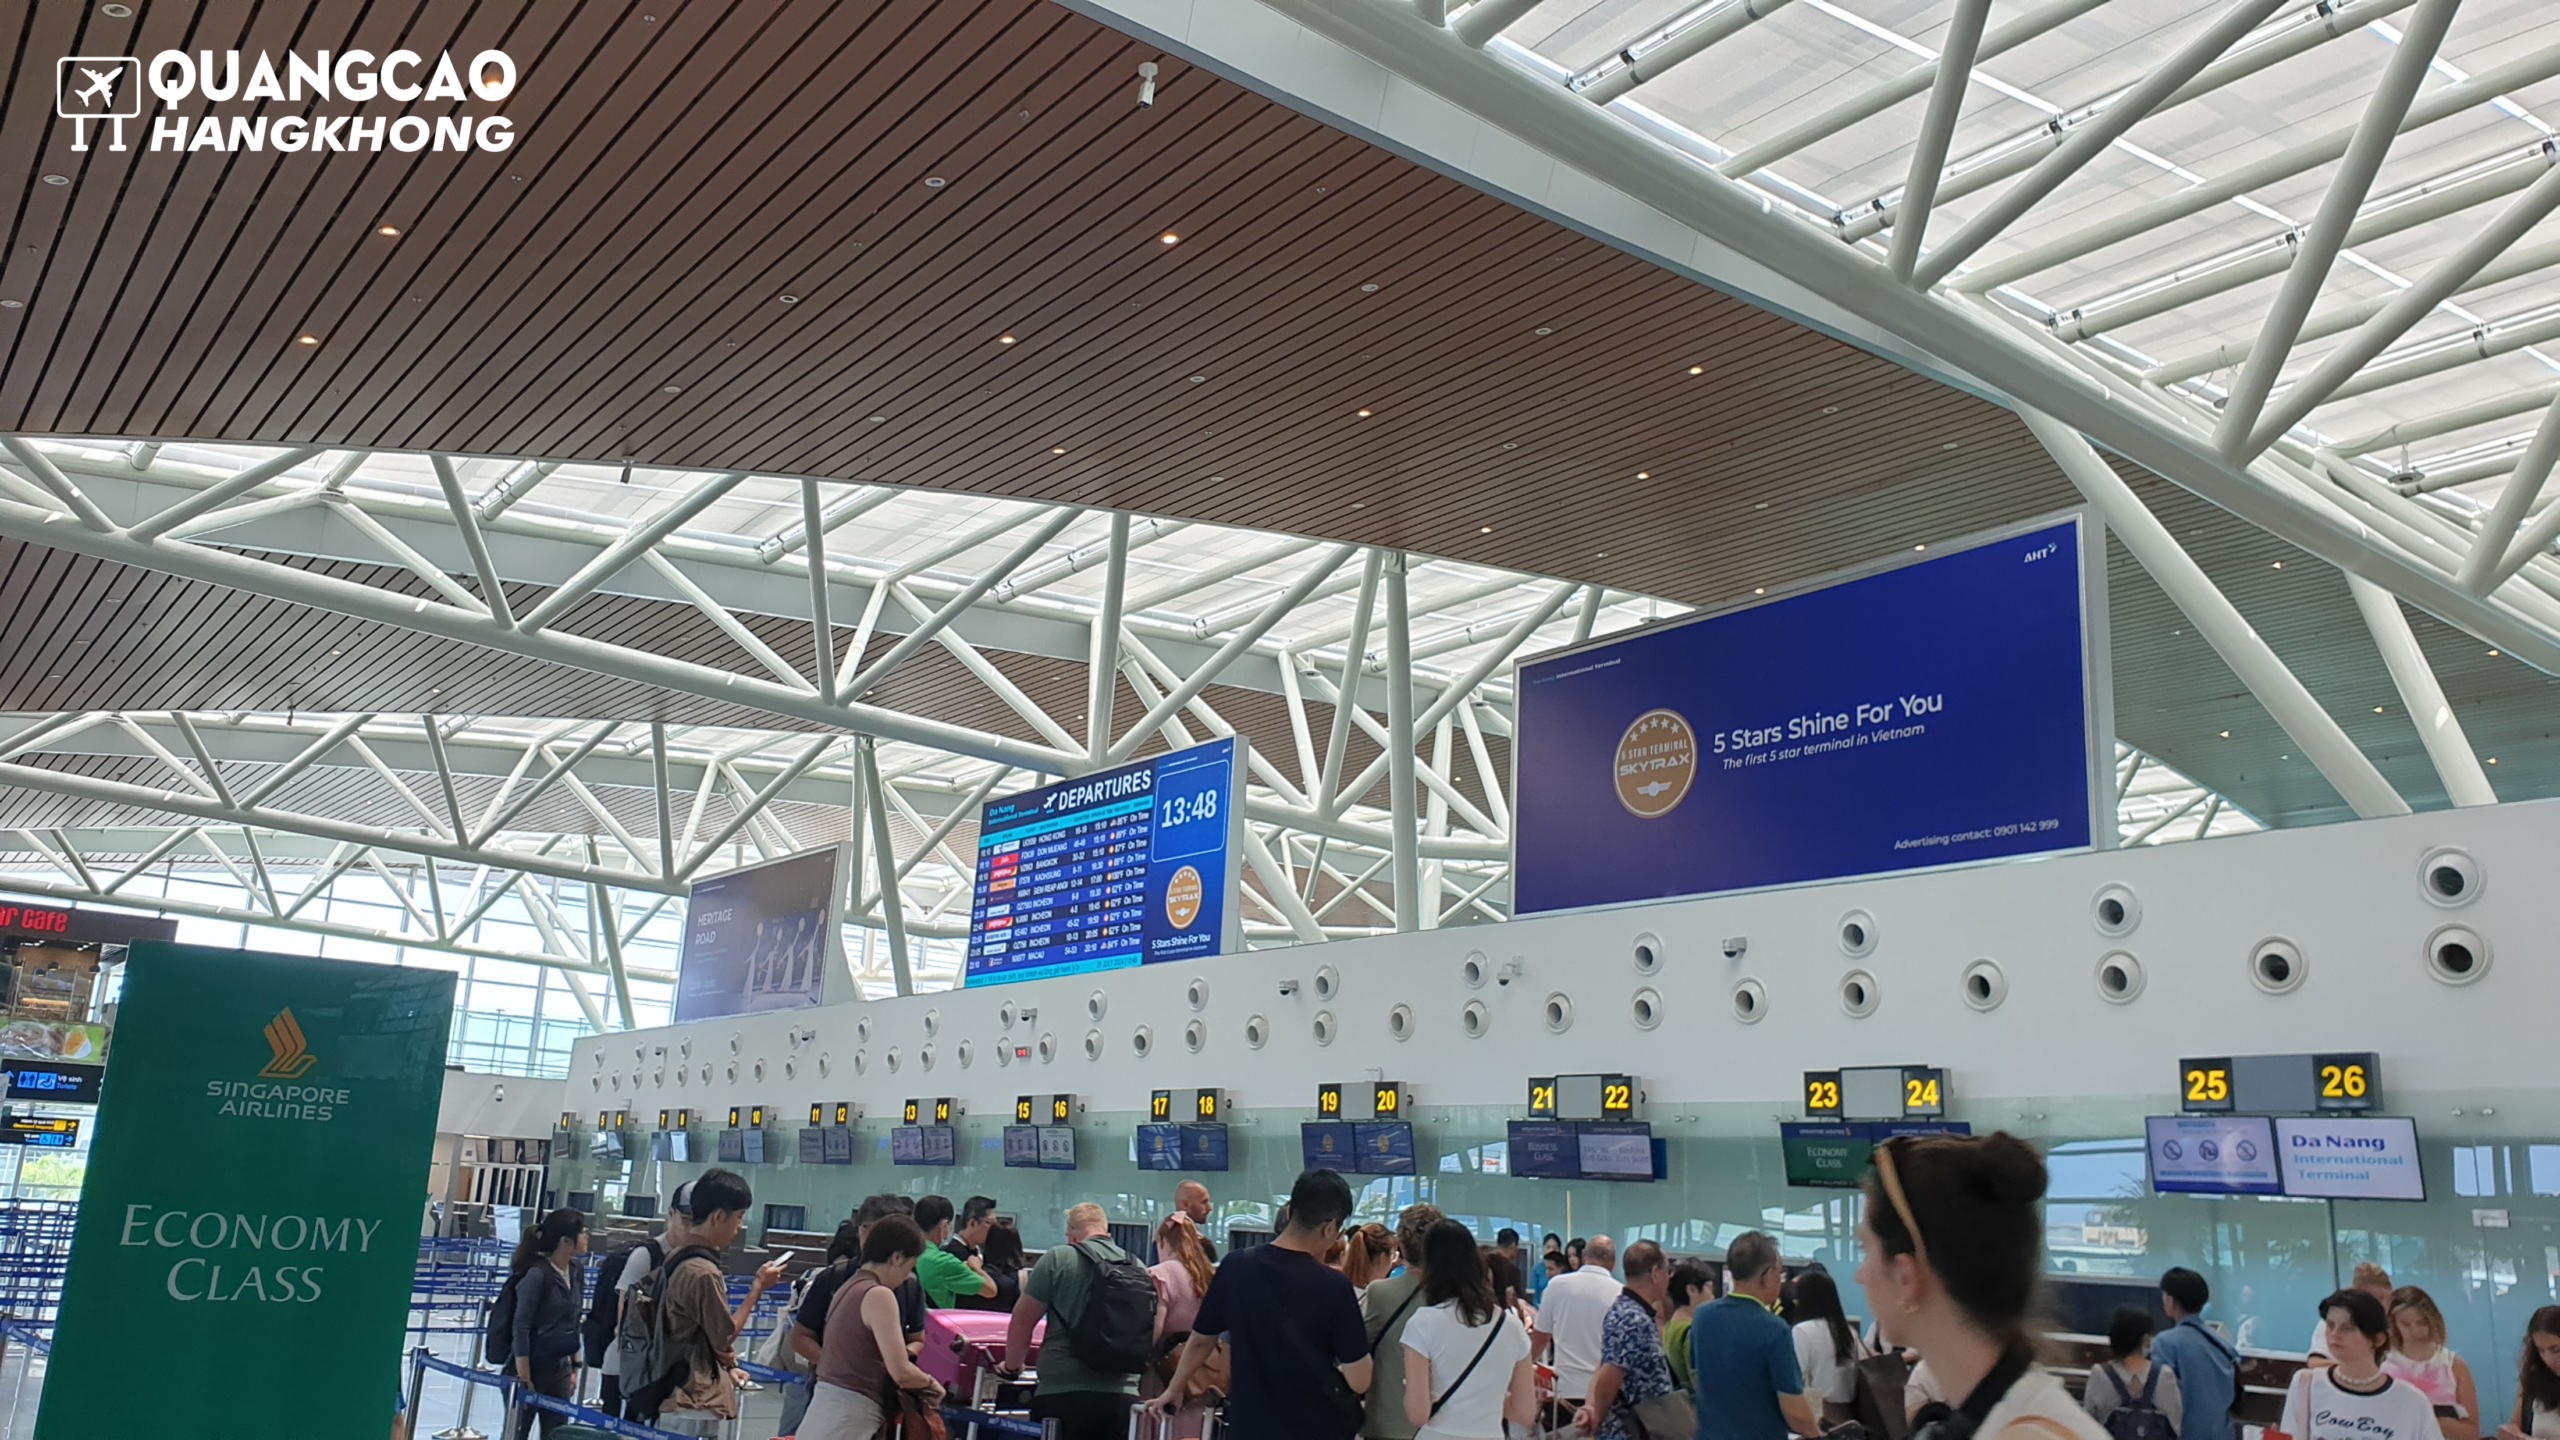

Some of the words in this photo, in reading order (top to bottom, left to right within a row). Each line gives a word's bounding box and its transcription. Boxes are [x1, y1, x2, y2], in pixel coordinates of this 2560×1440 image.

[2024, 548, 2048, 563] AHT
[1714, 732, 1726, 753] 5
[1732, 724, 1782, 750] Stars
[1788, 712, 1848, 739] Shine
[1856, 704, 1892, 726] For
[1900, 694, 1943, 718] You
[1628, 747, 1647, 760] STAR
[1650, 739, 1688, 754] TERMINAL
[1723, 758, 1742, 770] The
[1745, 754, 1768, 766] first
[1769, 750, 1776, 762] 5
[1778, 748, 1801, 760] star
[1804, 736, 1854, 756] terminal
[1856, 734, 1868, 746] in
[1872, 724, 1925, 743] Vietnam
[1620, 753, 1690, 776] SKYTRAX
[1058, 770, 1152, 810] DEPARTURES
[999, 804, 1014, 816] Nang
[1129, 813, 1137, 823] On
[1137, 810, 1149, 821] Time
[1161, 789, 1218, 828] 13:48
[1128, 826, 1136, 836] On
[1136, 824, 1148, 835] Time
[1894, 834, 1949, 850] Advertising
[1951, 828, 1992, 843] contact:
[1994, 825, 2018, 837] 0901
[2020, 822, 2036, 834] 142
[2038, 818, 2058, 830] 999
[1127, 840, 1135, 850] On
[1135, 837, 1147, 848] Time
[1126, 854, 1134, 864] On
[1134, 851, 1146, 862] Time
[1125, 868, 1133, 878] On
[1133, 865, 1145, 876] Time
[1124, 881, 1132, 892] On
[1132, 879, 1144, 890] Time
[1123, 895, 1131, 905] On
[1131, 893, 1143, 904] Time
[22, 908, 68, 932] Cafe
[698, 908, 733, 927] HERITAGE
[1122, 910, 1130, 920] On
[1130, 908, 1142, 918] Time
[1121, 924, 1129, 934] On
[1129, 922, 1141, 932] Time
[695, 931, 716, 946] ROAD
[1120, 938, 1128, 948] On
[1128, 936, 1140, 947] Time
[1152, 940, 1156, 950] 5
[1156, 938, 1171, 948] Stars
[1171, 935, 1188, 946] Shine
[1188, 934, 1198, 944] For
[1199, 933, 1211, 942] You
[2186, 1069, 2228, 1101] 25
[2320, 1064, 2366, 1098] 26
[206, 1080, 350, 1105] SINGAPORE
[1320, 1090, 1338, 1112] 19
[1377, 1090, 1396, 1111] 20
[1532, 1086, 1553, 1109] 21
[1604, 1084, 1630, 1108] 22
[1808, 1081, 1838, 1108] 23
[1907, 1079, 1938, 1106] 24
[218, 1100, 332, 1122] AIRLINES
[906, 1105, 916, 1120] 13
[937, 1104, 947, 1120] 14
[1017, 1101, 1030, 1119] 15
[1054, 1100, 1066, 1118] 16
[1152, 1098, 1168, 1116] 17
[1199, 1096, 1214, 1115] 18
[600, 1115, 605, 1126] 5
[661, 1114, 666, 1126] 7
[730, 1111, 736, 1124] 9
[752, 1110, 760, 1124] 10
[812, 1108, 820, 1122] 11
[838, 1108, 846, 1122] 12
[1807, 1146, 1848, 1157] ECONOMY
[2292, 1134, 2320, 1148] Da
[2326, 1134, 2386, 1152] Nang
[1816, 1158, 1842, 1168] CLASS
[2294, 1153, 2404, 1166] International
[2298, 1169, 2370, 1182] Terminal
[119, 1204, 382, 1252] ECONOMY
[166, 1258, 324, 1302] CLASS
